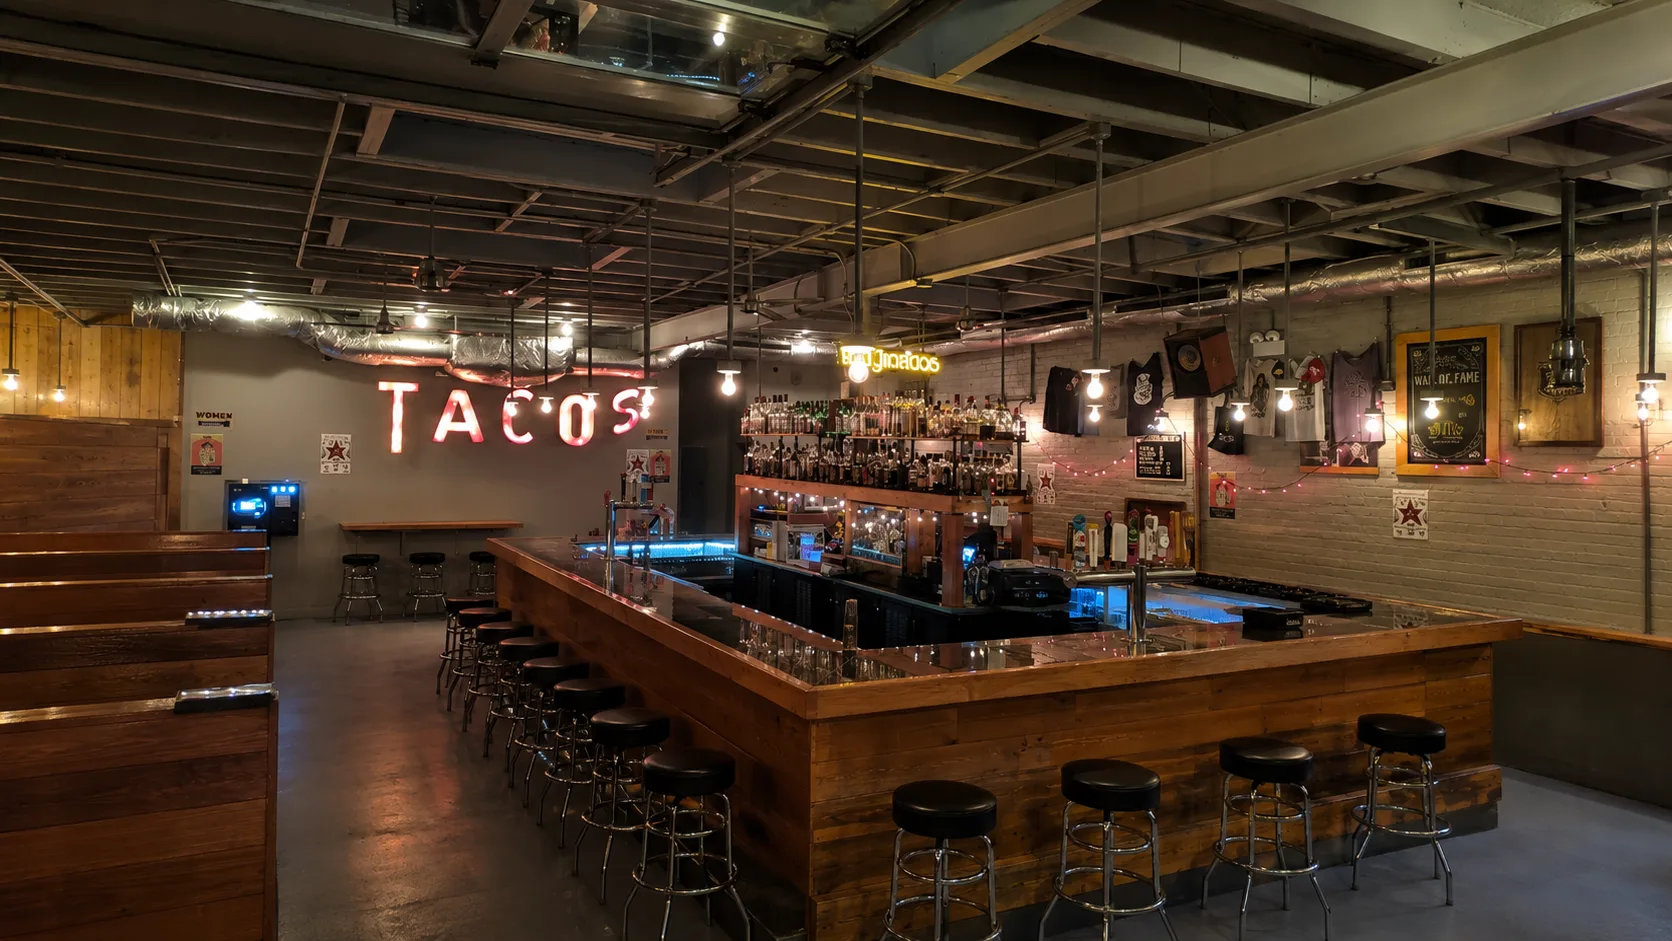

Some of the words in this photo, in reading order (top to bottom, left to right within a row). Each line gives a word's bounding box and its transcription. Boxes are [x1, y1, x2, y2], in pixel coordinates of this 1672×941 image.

[1454, 371, 1480, 384] FAME
[196, 411, 232, 419] WOMEN
[377, 380, 641, 454] TACOS
